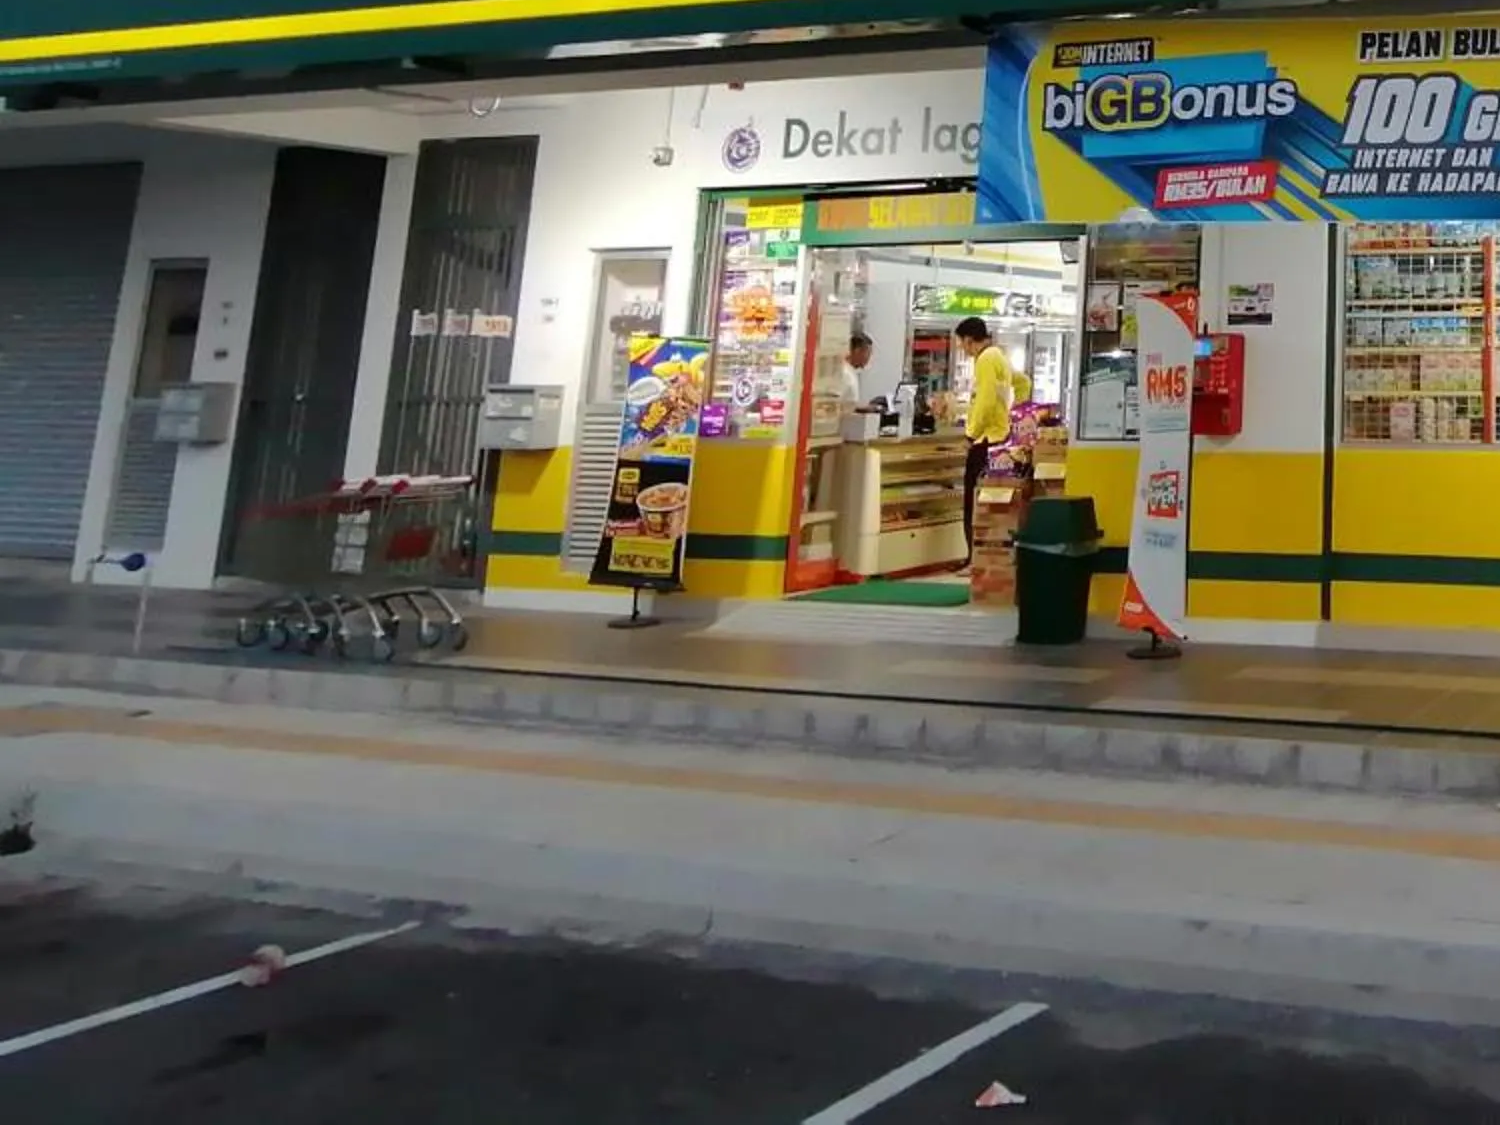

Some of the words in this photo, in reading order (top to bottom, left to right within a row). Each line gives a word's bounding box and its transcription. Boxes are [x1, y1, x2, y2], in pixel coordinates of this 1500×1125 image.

[1081, 40, 1151, 65] INTERNET
[1359, 29, 1442, 60] PELAN
[1044, 72, 1297, 132] biGBonus
[1341, 76, 1458, 145] 100
[782, 110, 903, 160] Dekat
[1353, 147, 1445, 170] INTERNET
[1451, 146, 1495, 168] DAN
[1325, 173, 1379, 195] BAWA
[1385, 173, 1411, 194] KE
